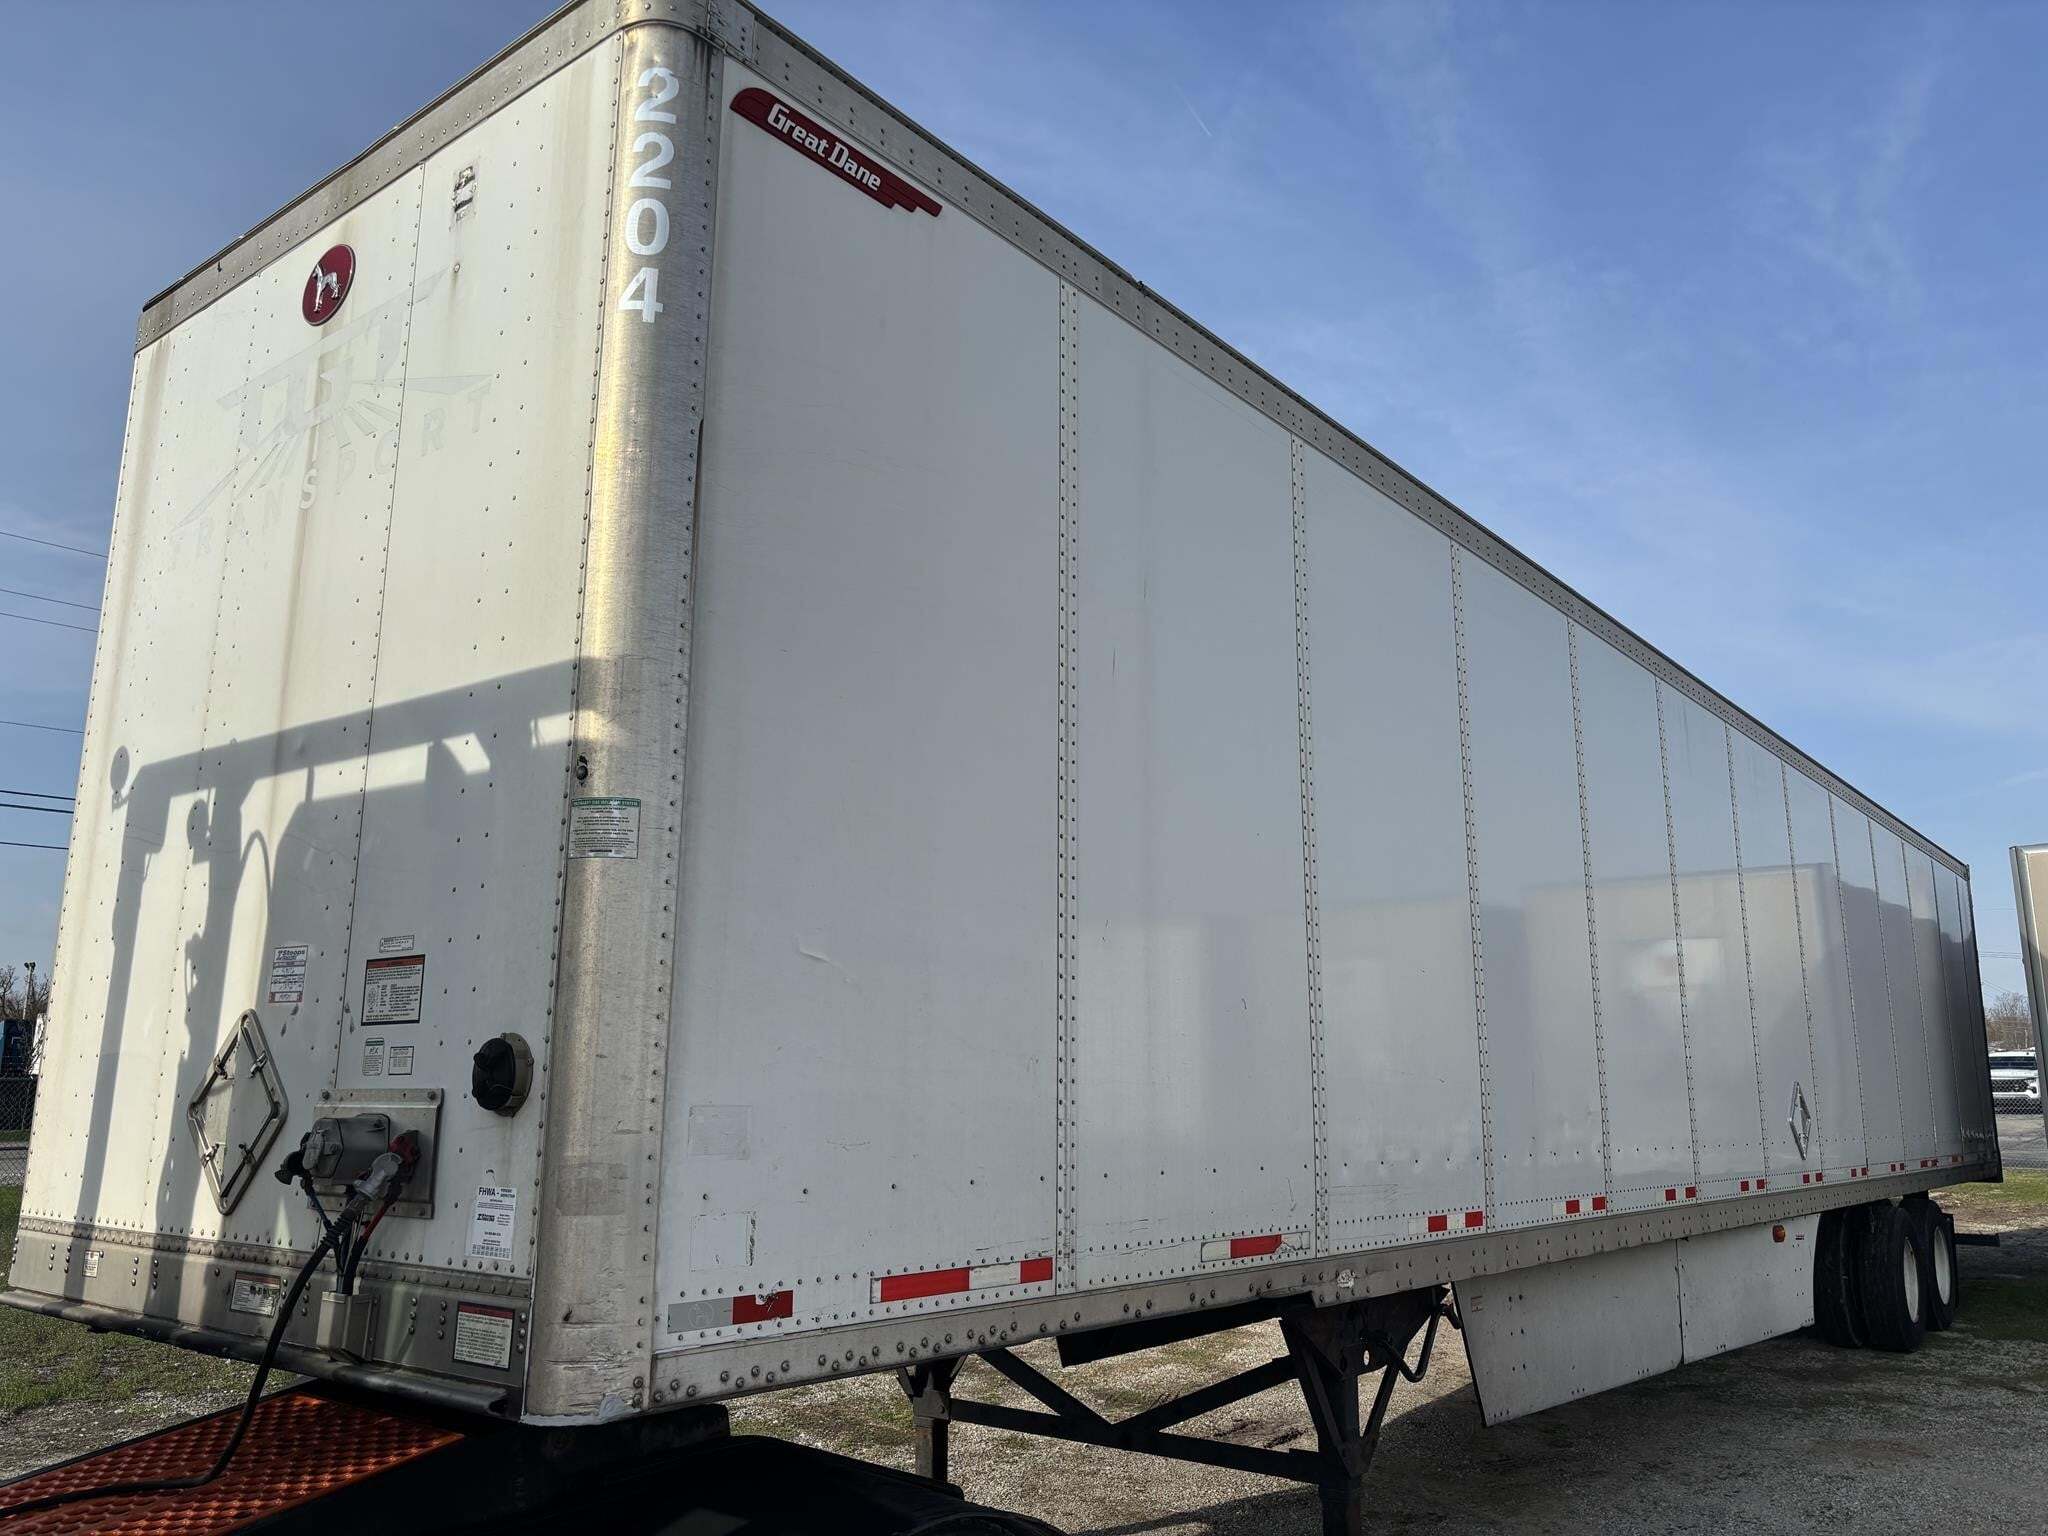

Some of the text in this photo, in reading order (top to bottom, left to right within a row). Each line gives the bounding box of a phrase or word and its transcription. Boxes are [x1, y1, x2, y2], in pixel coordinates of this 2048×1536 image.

[767, 103, 881, 191] Great Dane
[617, 67, 680, 324] 2204
[479, 1187, 496, 1197] FHWA
